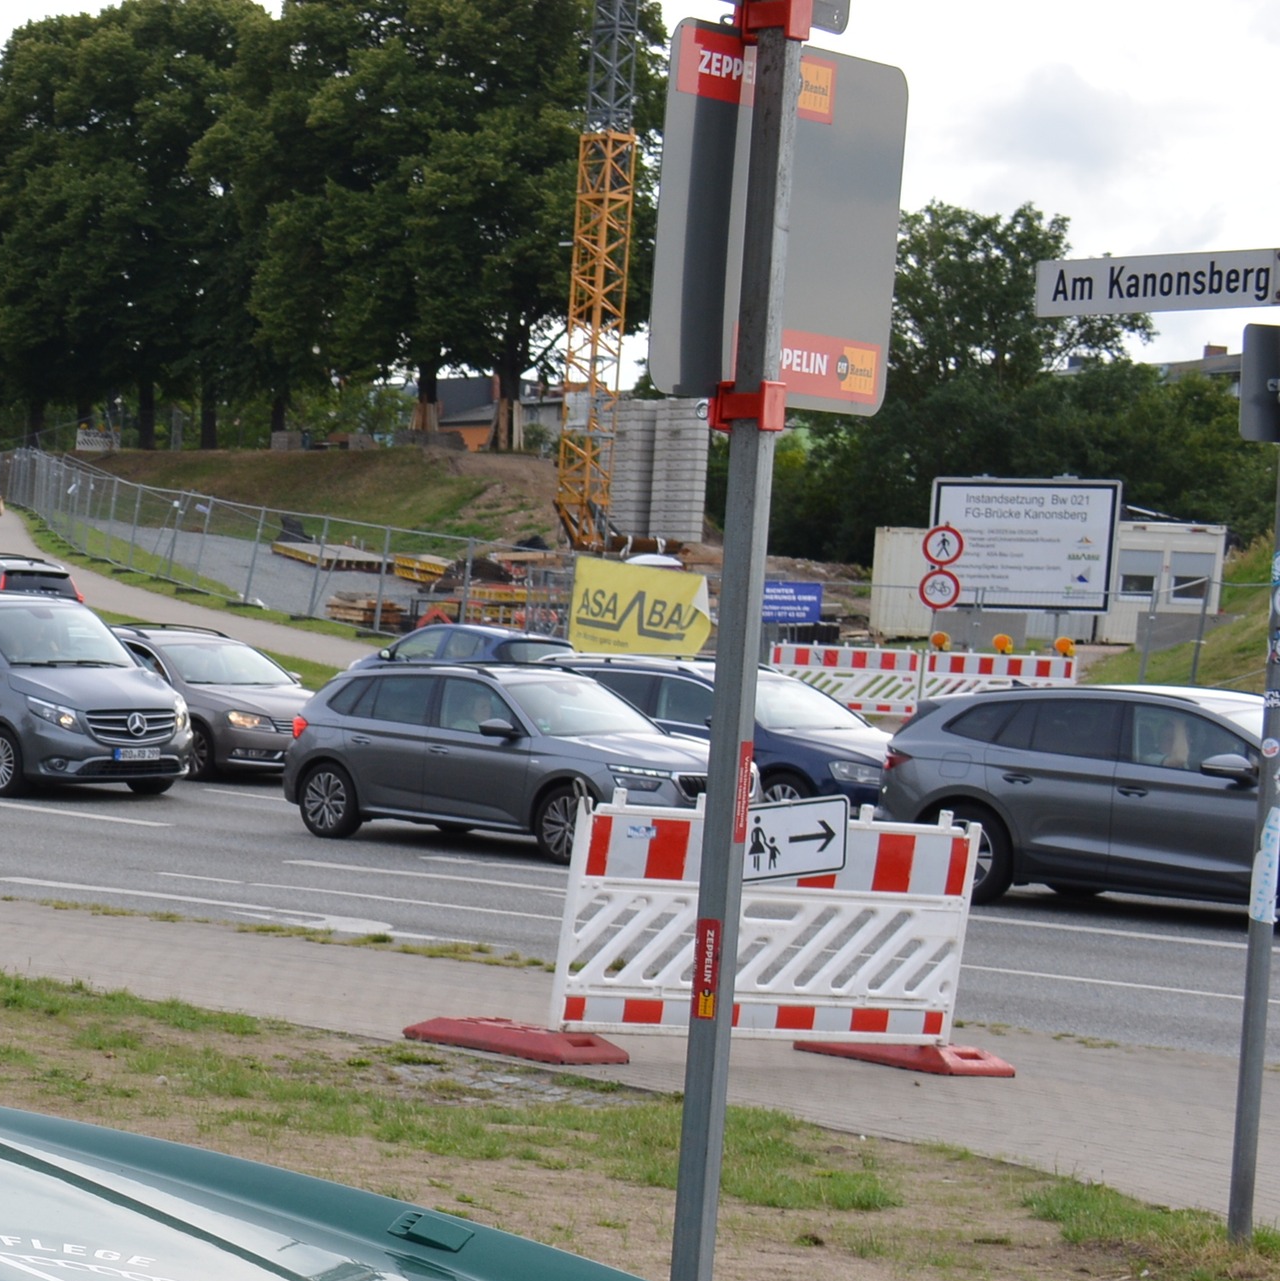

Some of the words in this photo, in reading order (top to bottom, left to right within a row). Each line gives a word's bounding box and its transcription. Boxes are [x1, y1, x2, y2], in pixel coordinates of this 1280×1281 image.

[698, 50, 755, 84] ZEPPE
[804, 80, 829, 97] Rental
[1052, 269, 1093, 302] Am
[1108, 261, 1270, 302] Kanonsberg
[780, 347, 828, 376] PELIN
[849, 363, 873, 379] Rental
[965, 507, 1021, 520] FG-Brücke
[1024, 509, 1088, 522] Kanonsberg
[966, 493, 1045, 507] Instandsetzung
[1051, 494, 1069, 505] Bw
[1070, 494, 1090, 506] 021
[577, 588, 618, 620] ASA
[646, 599, 699, 631] BAU
[704, 929, 715, 984] ZEPPELIN
